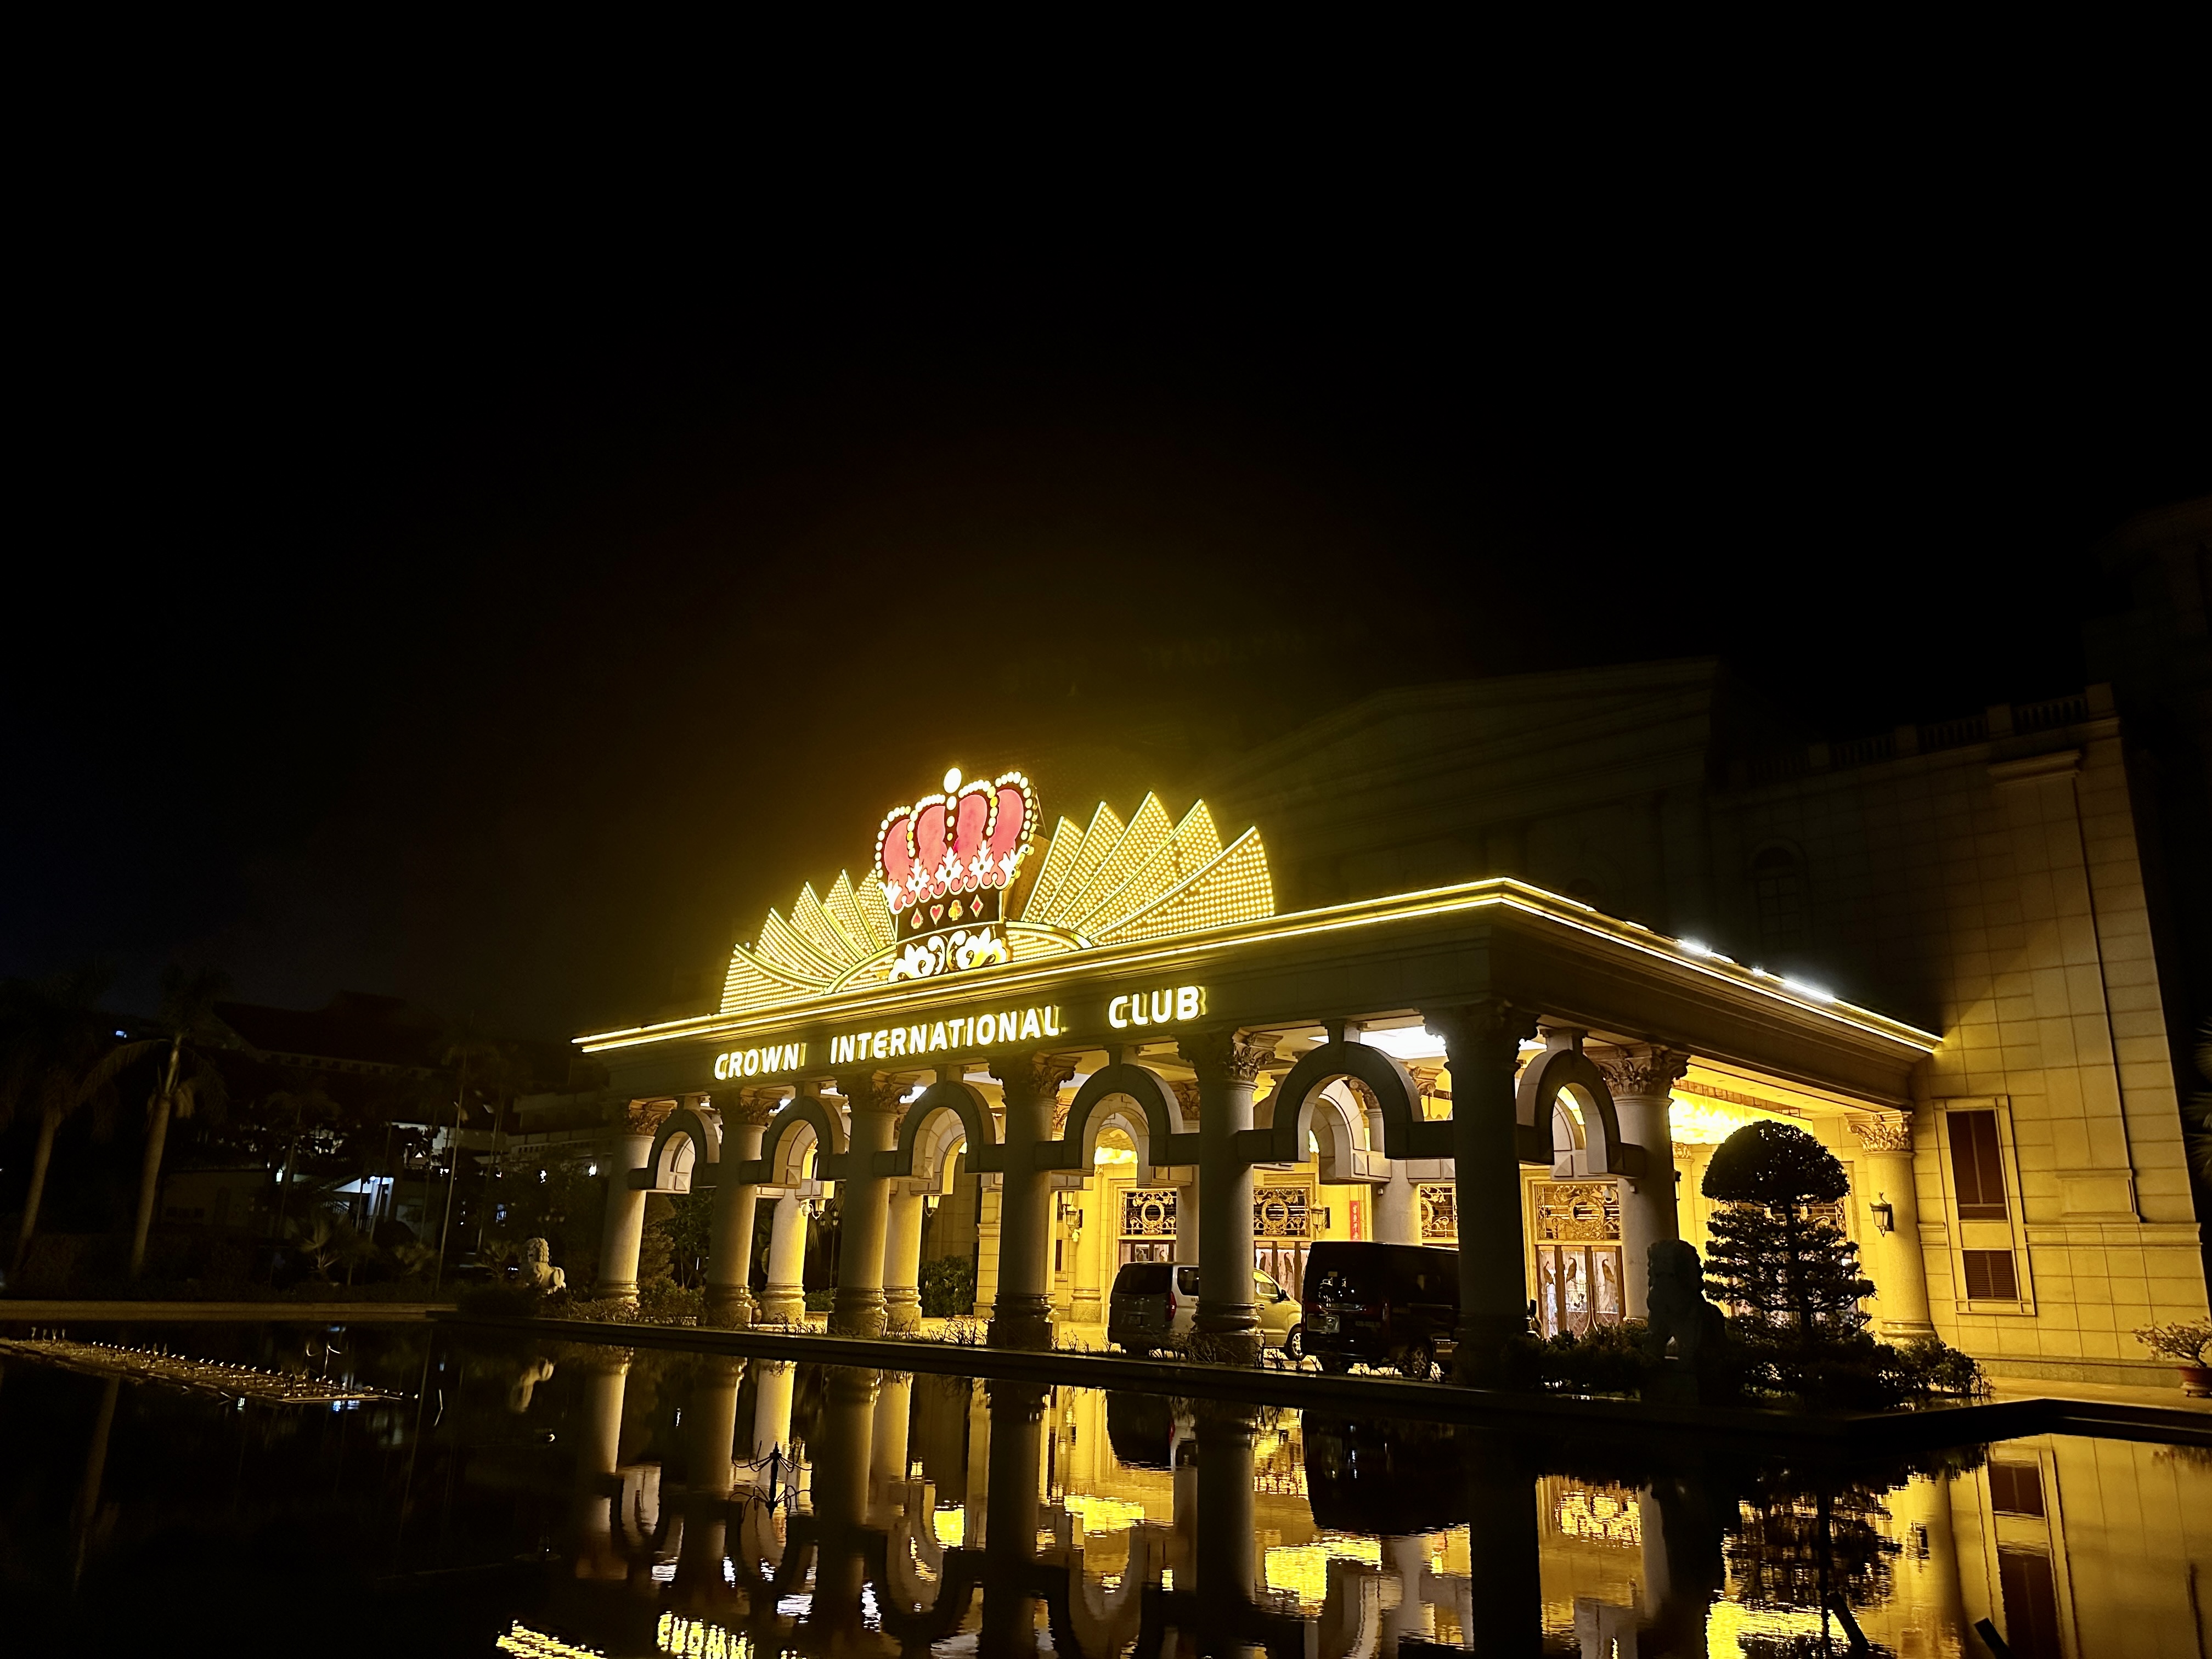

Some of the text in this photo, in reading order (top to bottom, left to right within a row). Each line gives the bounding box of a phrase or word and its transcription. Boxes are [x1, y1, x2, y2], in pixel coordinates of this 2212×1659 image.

[714, 986, 1203, 1080] CROWN INTERNATIONAL CLUB
